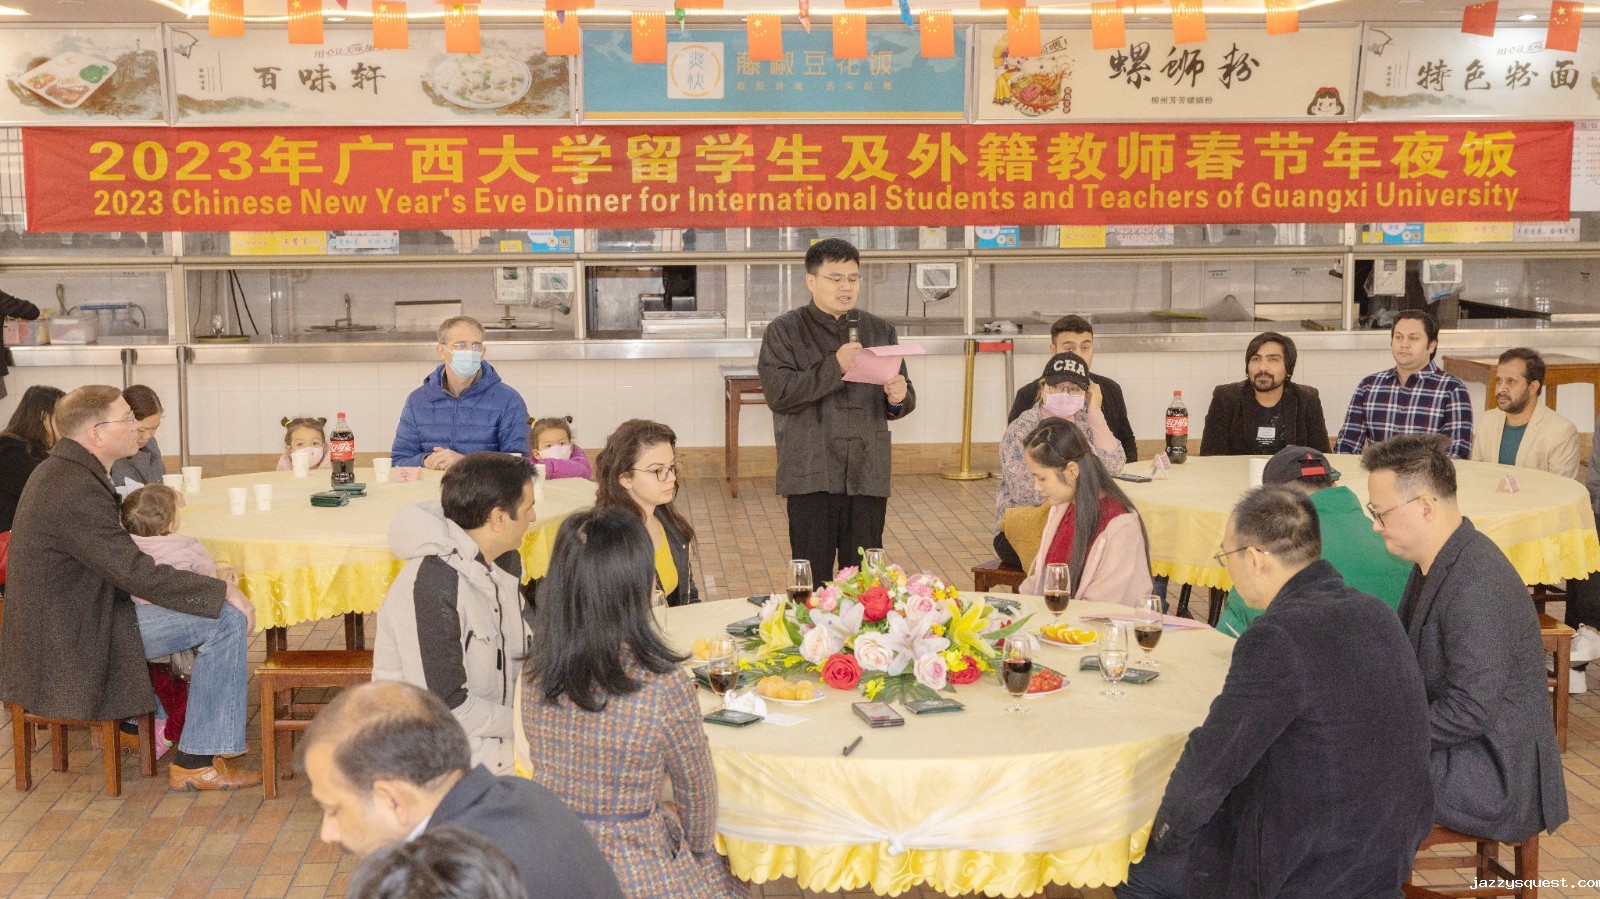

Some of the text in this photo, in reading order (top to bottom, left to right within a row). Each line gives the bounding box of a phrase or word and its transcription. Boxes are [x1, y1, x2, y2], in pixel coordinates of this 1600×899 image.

[253, 61, 387, 95] 百味轩
[1416, 59, 1580, 92] 特色粉面
[89, 130, 1517, 186] 2023年广西大学留学生及外籍教师春节年夜饭
[94, 180, 1520, 216] 2023 Chinese New Year's Eve Dinner for International Students and Teachers of Guangxi University
[1053, 359, 1086, 377] CHA
